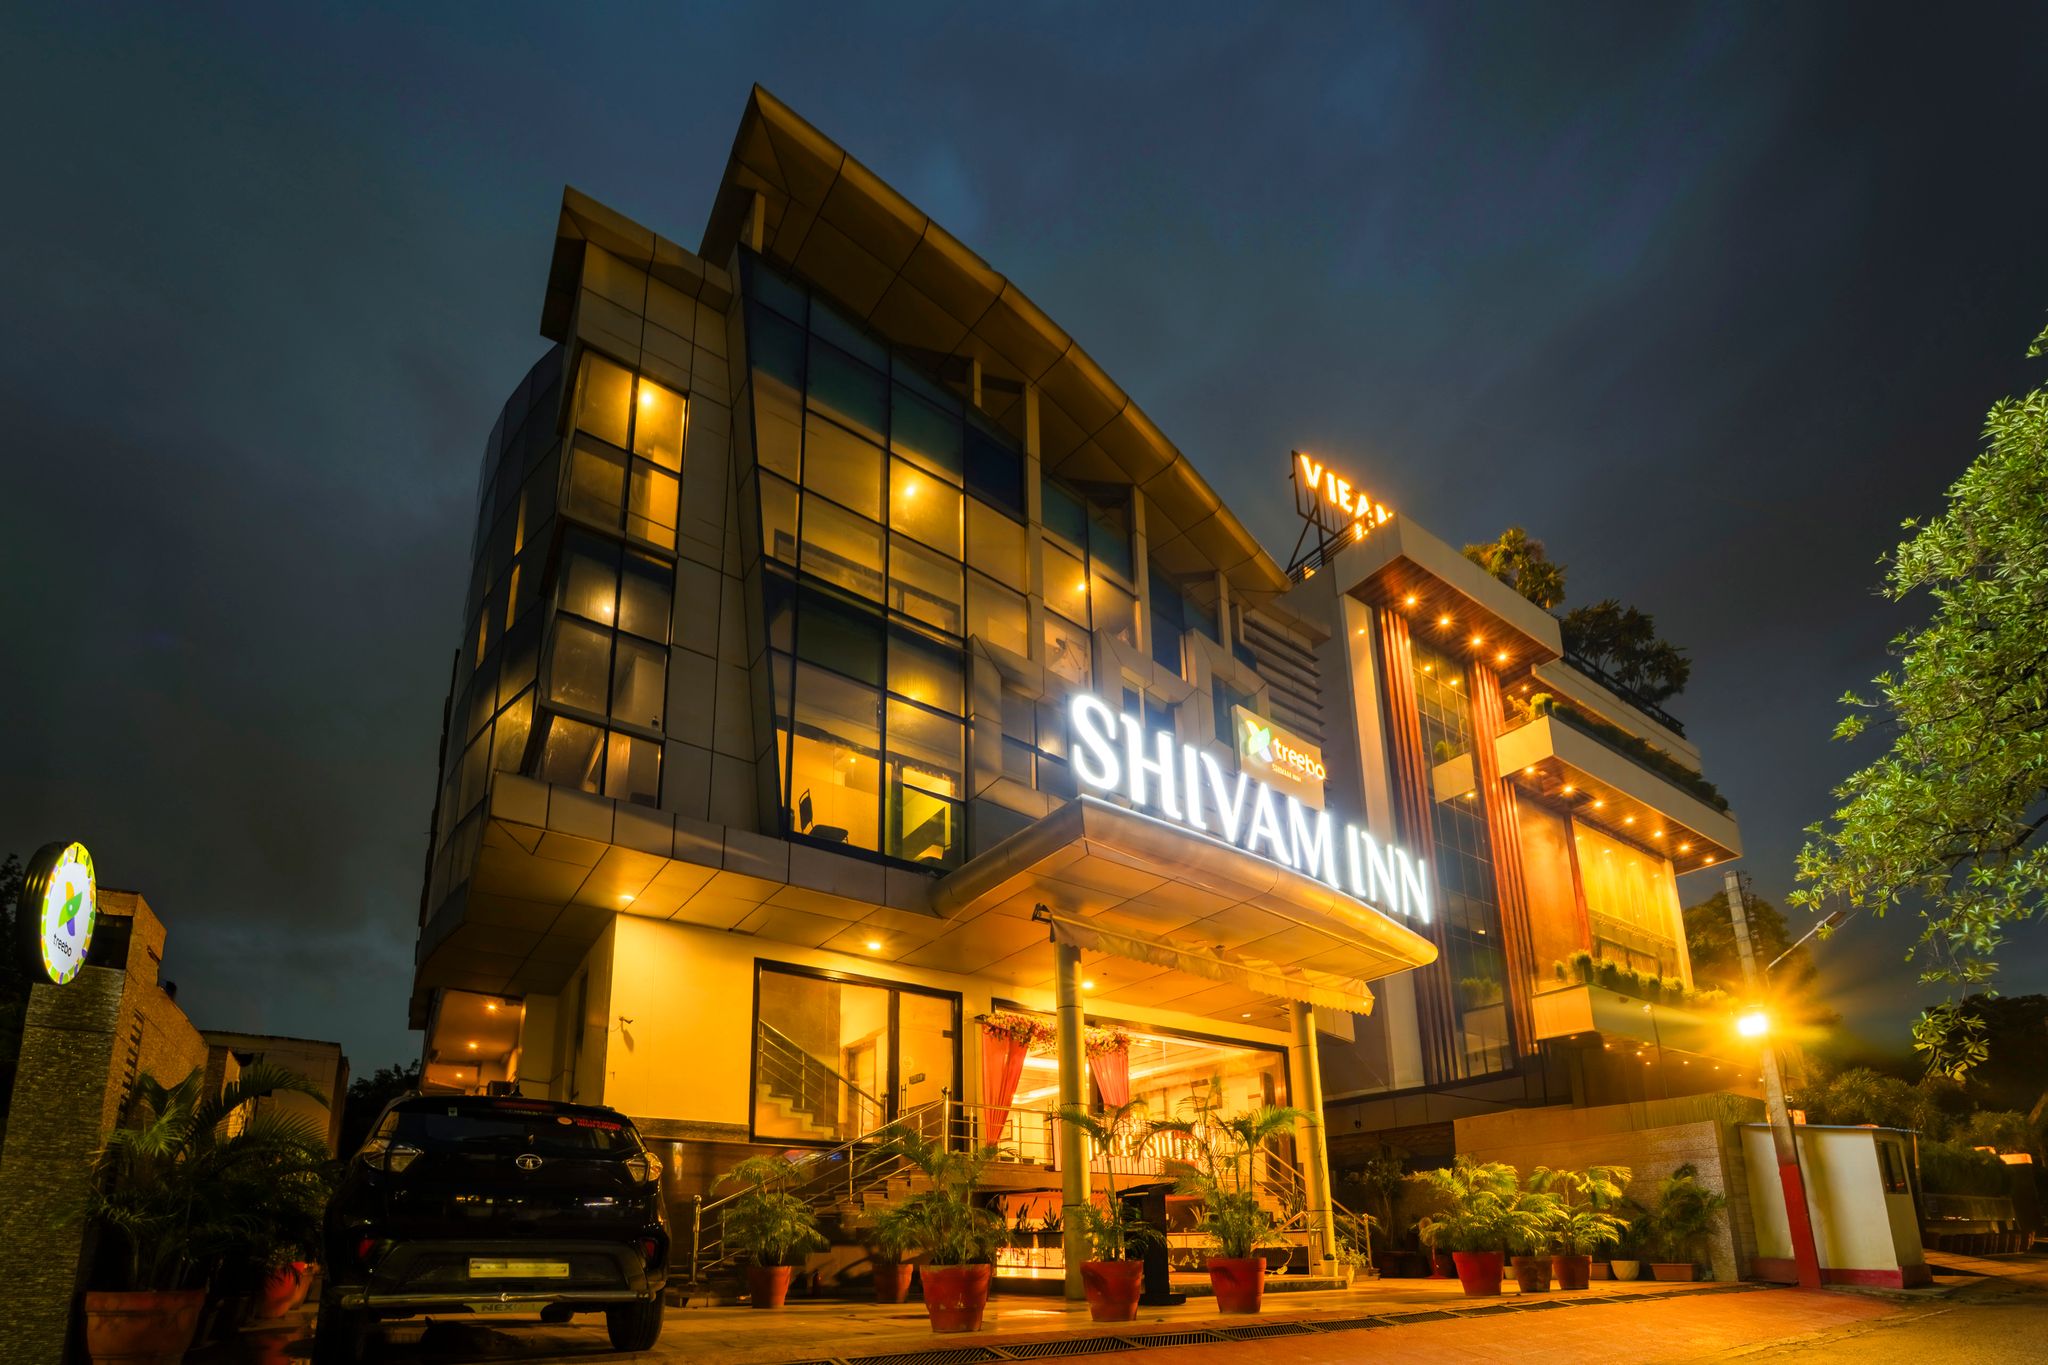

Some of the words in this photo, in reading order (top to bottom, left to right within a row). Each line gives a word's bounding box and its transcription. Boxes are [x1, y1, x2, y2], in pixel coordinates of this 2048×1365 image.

[1273, 737, 1326, 780] treebo
[1072, 694, 1339, 890] SHIVAM
[1347, 824, 1430, 924] INN
[53, 934, 72, 957] treebo
